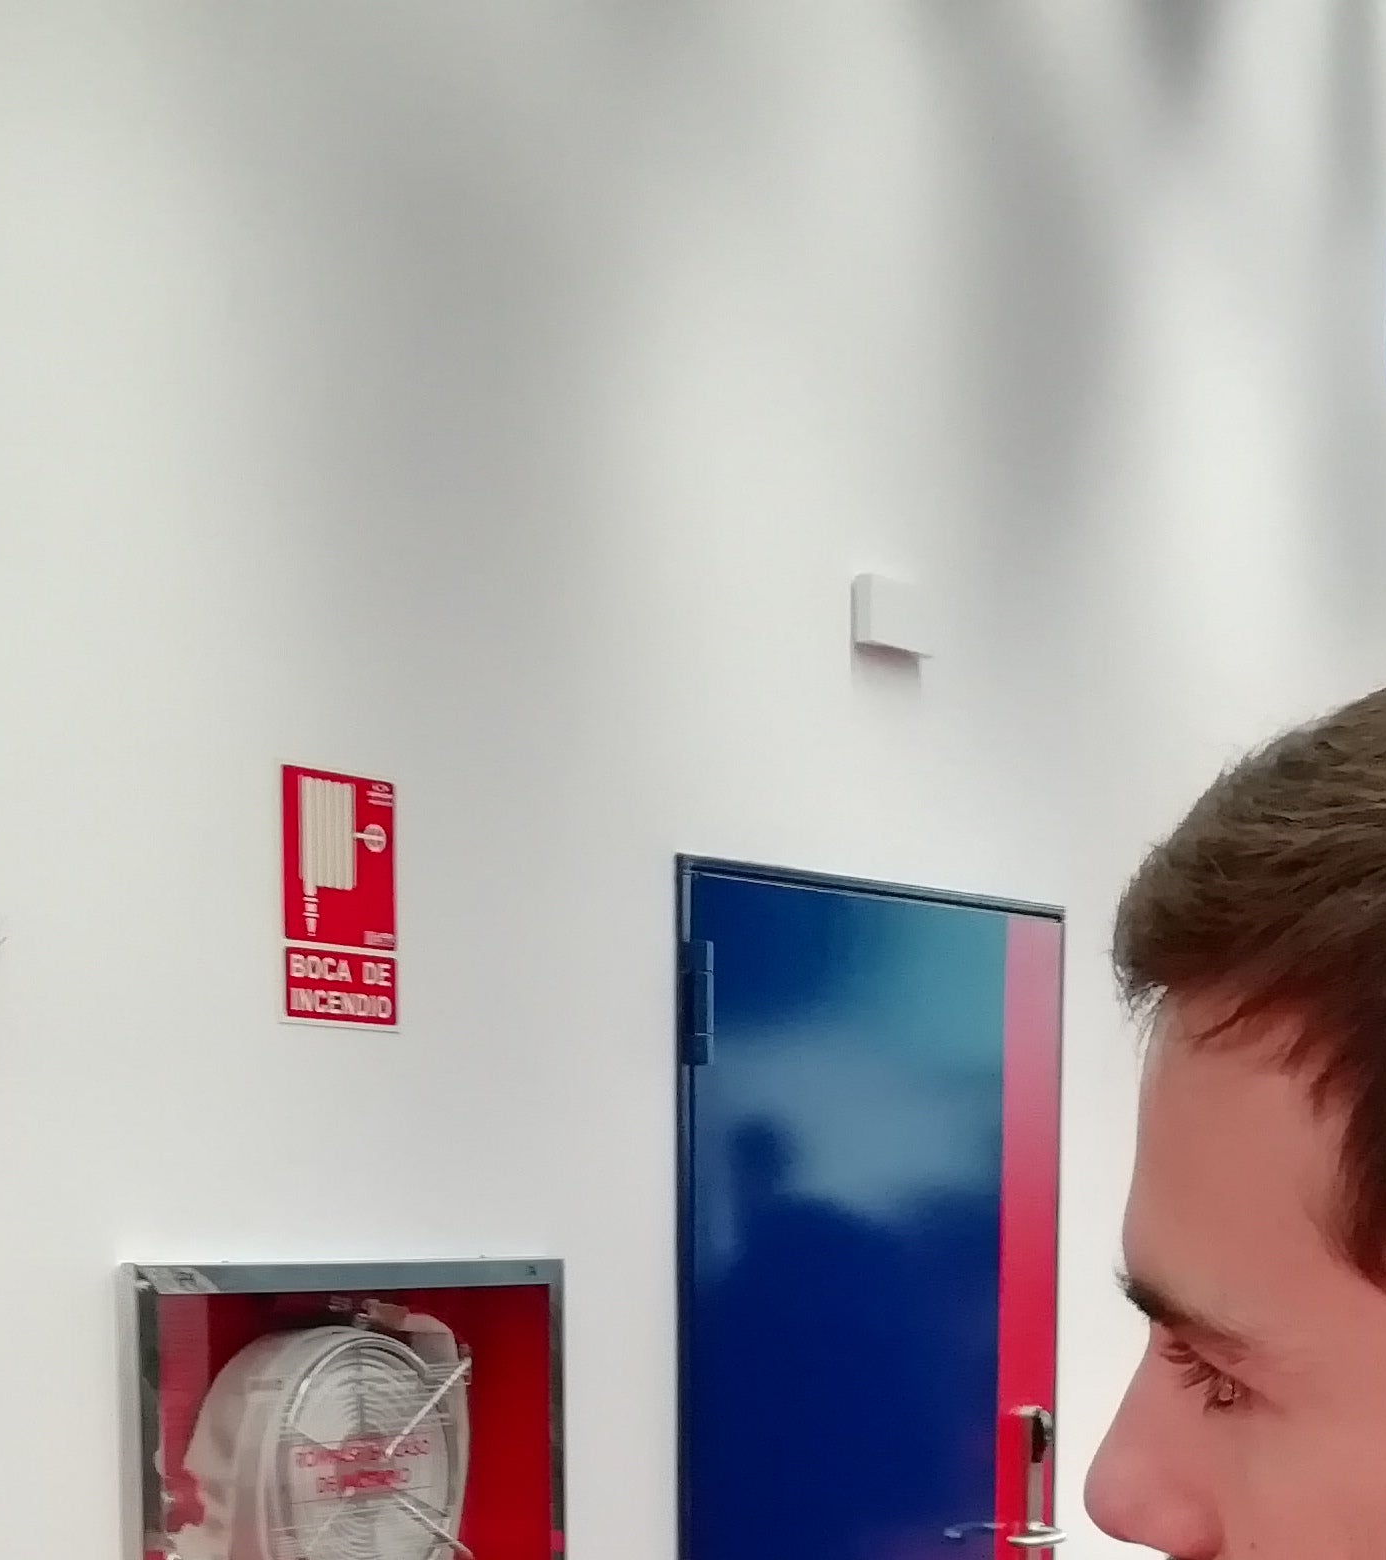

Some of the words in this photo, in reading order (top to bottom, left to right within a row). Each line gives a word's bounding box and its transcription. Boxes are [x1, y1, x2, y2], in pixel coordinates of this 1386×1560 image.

[289, 953, 353, 983] BOCA
[361, 961, 393, 987] DE
[289, 987, 393, 1019] INCENDIO
